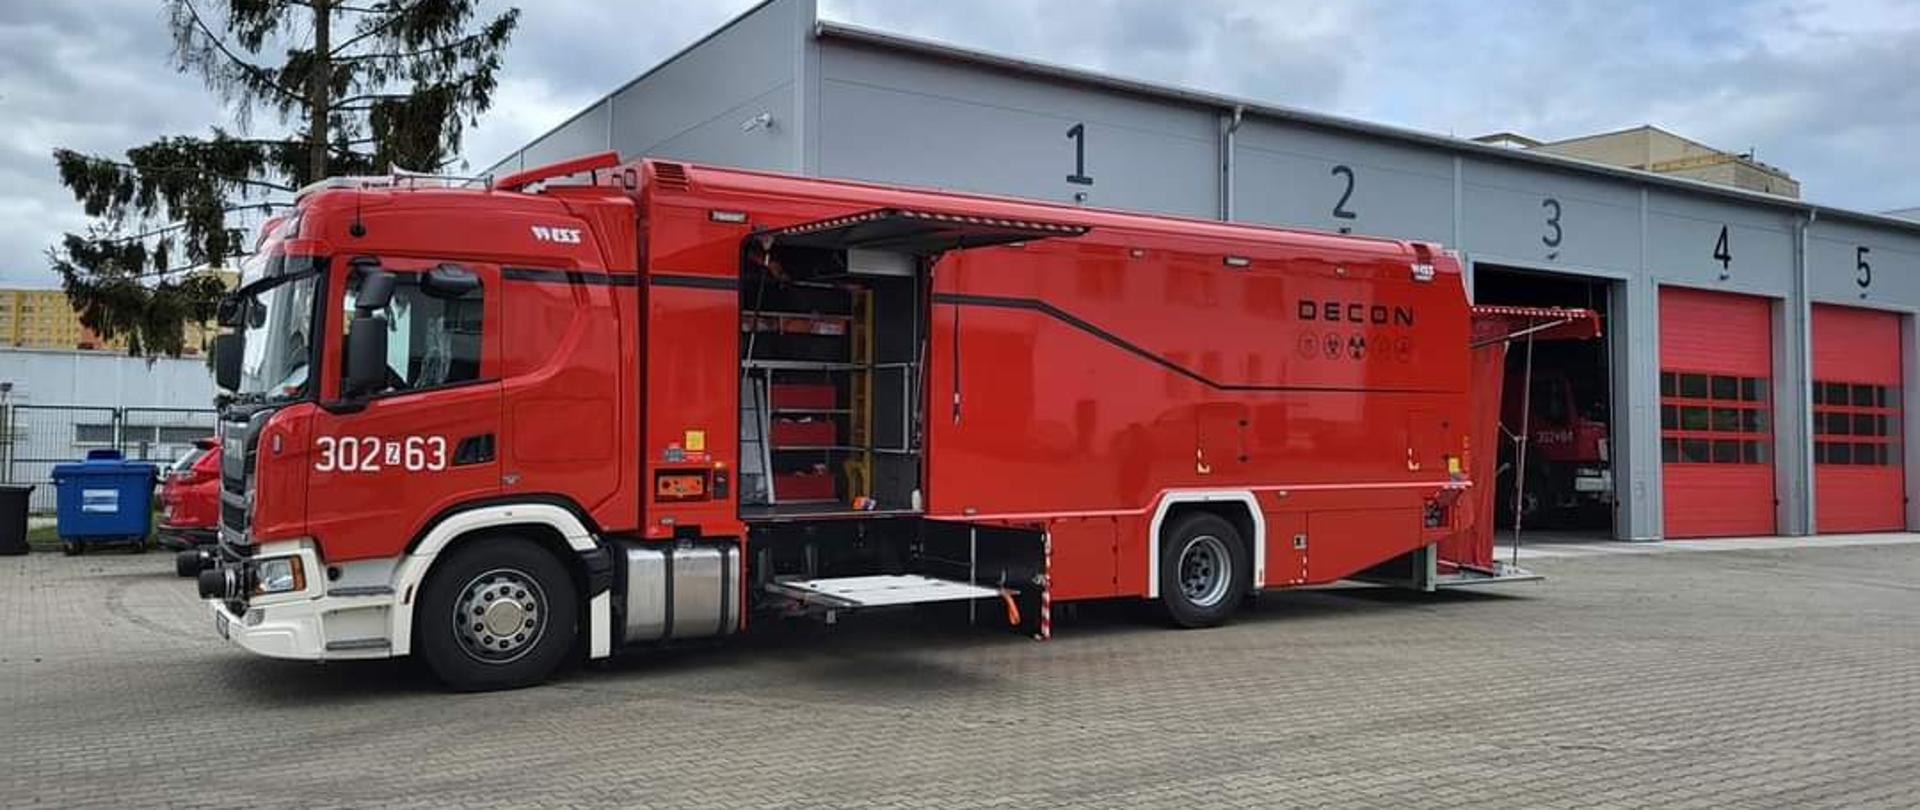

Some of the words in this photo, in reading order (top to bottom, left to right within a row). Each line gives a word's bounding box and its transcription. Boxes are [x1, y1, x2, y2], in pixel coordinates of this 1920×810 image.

[1066, 123, 1094, 186] 1
[1331, 165, 1357, 219] 2
[1542, 199, 1562, 247] 3
[1713, 225, 1731, 270] 4
[1857, 246, 1871, 288] 5
[1298, 299, 1414, 327] DECON
